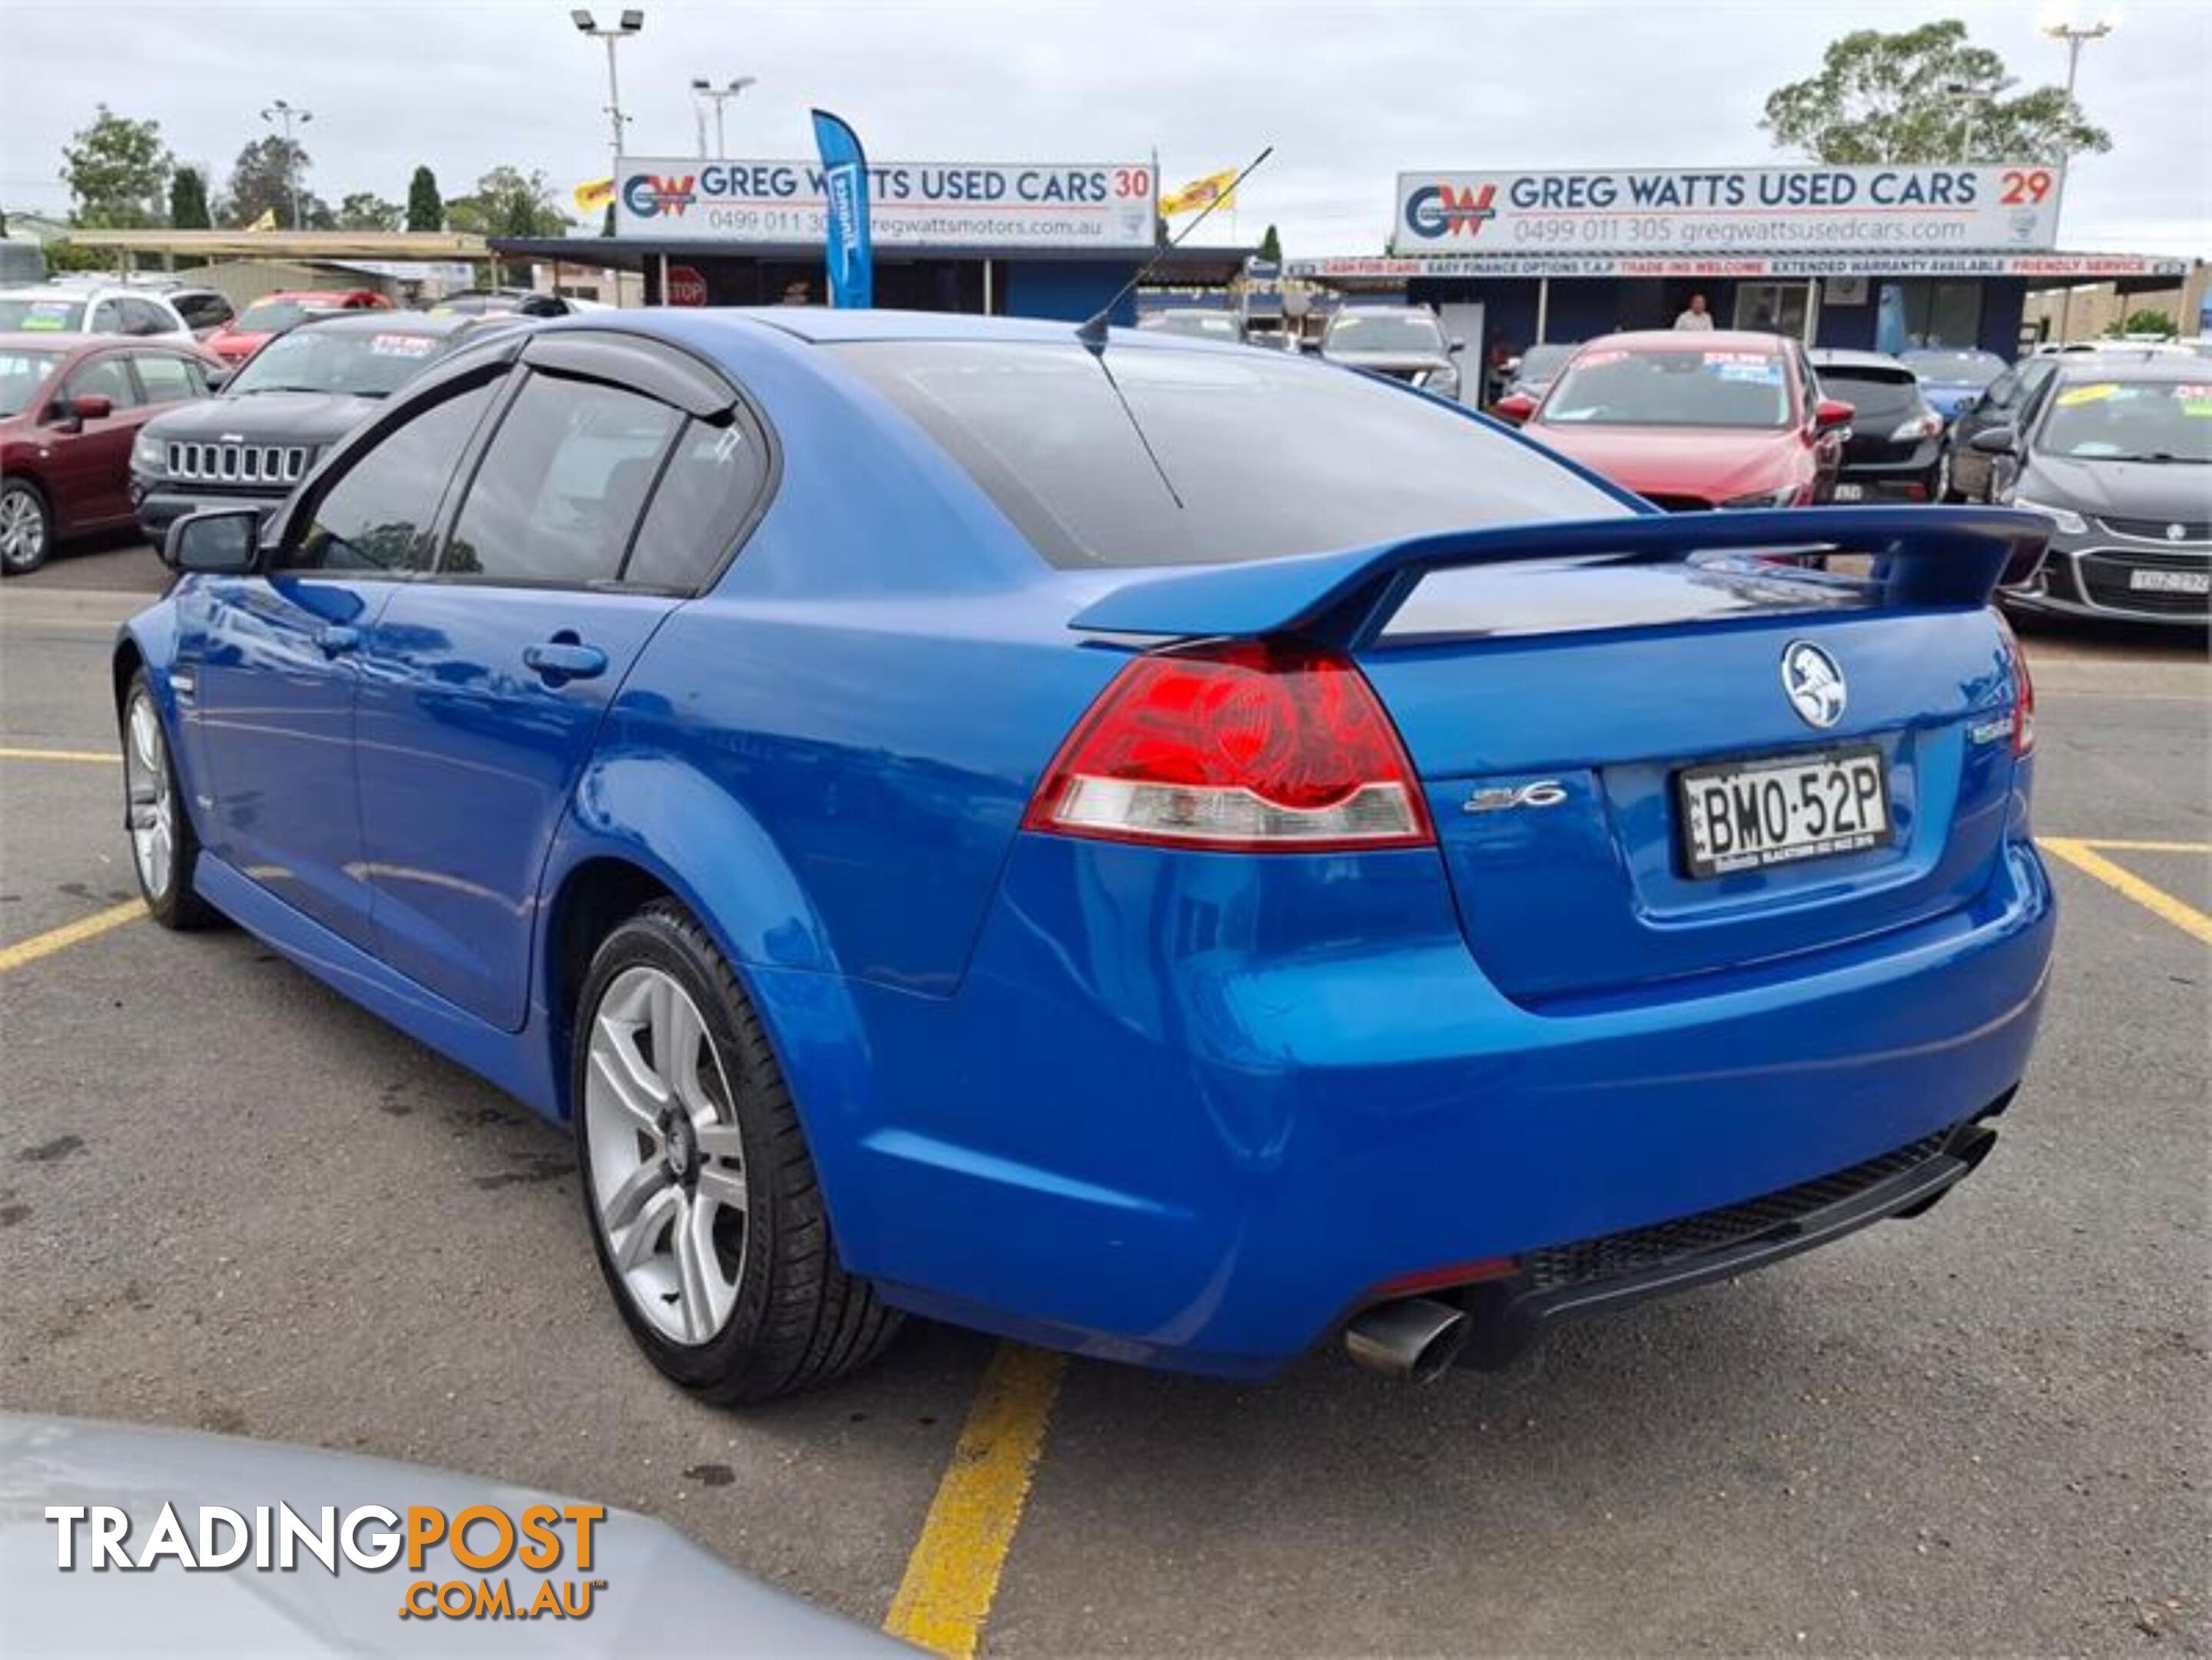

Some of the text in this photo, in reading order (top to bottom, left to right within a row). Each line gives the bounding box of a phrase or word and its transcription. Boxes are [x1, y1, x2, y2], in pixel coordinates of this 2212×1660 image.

[701, 167, 1149, 201] GREG WTS USED CARS 30
[1511, 170, 2052, 208] GREG WATTS USED CARS 29
[709, 211, 758, 230] 0499
[764, 212, 800, 231] 011
[872, 217, 1102, 238] regwattsmotors.com.au
[1514, 217, 1965, 245] 0499 011 305 gregwattsusedcars.com
[1386, 261, 1420, 273] CARS
[1428, 261, 1460, 273] EASY
[1464, 261, 1518, 273] FINANCE
[1523, 261, 1578, 273] OPTIONS
[1696, 261, 1763, 273] WELCOME
[1771, 261, 1846, 273] EXTENDED
[1851, 261, 1926, 273] WARRANTY
[1931, 261, 2005, 273] AVAILABLE
[2011, 261, 2079, 272] FRIENDLY
[2086, 261, 2146, 272] SERVICE
